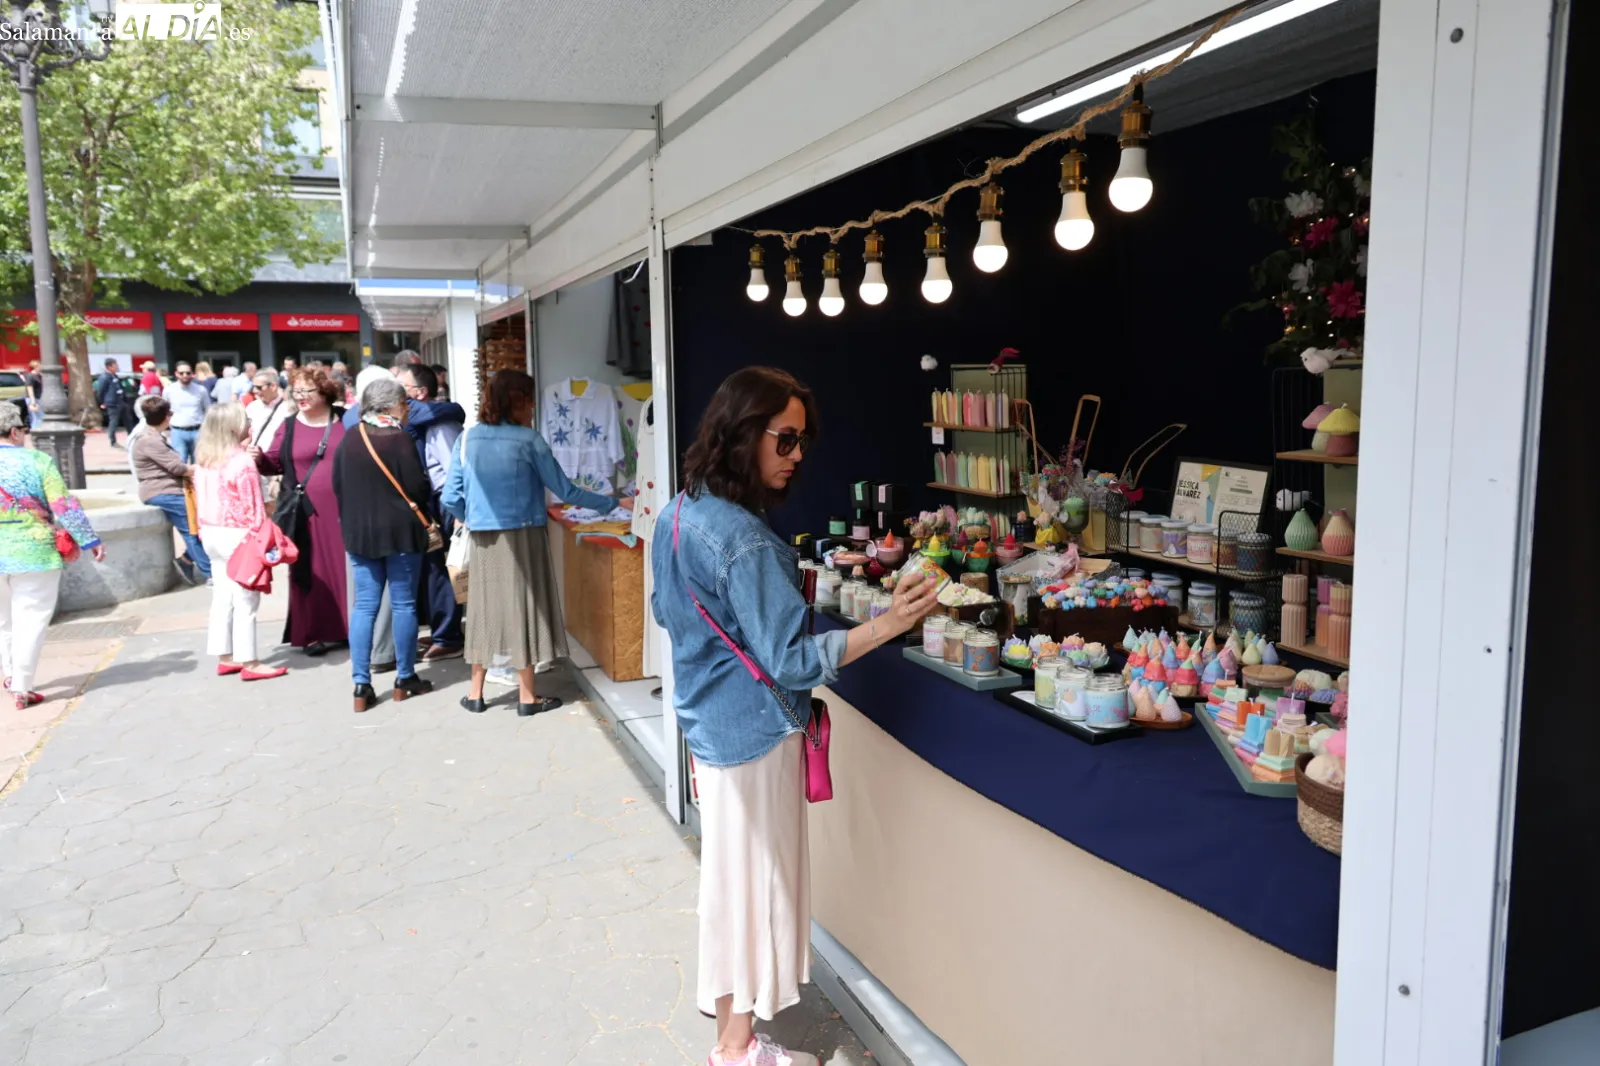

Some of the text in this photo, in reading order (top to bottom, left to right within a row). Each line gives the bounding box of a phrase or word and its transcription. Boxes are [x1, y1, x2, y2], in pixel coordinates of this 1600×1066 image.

[85, 315, 134, 325] Santander
[195, 316, 242, 326] Santander
[299, 317, 344, 327] Santander
